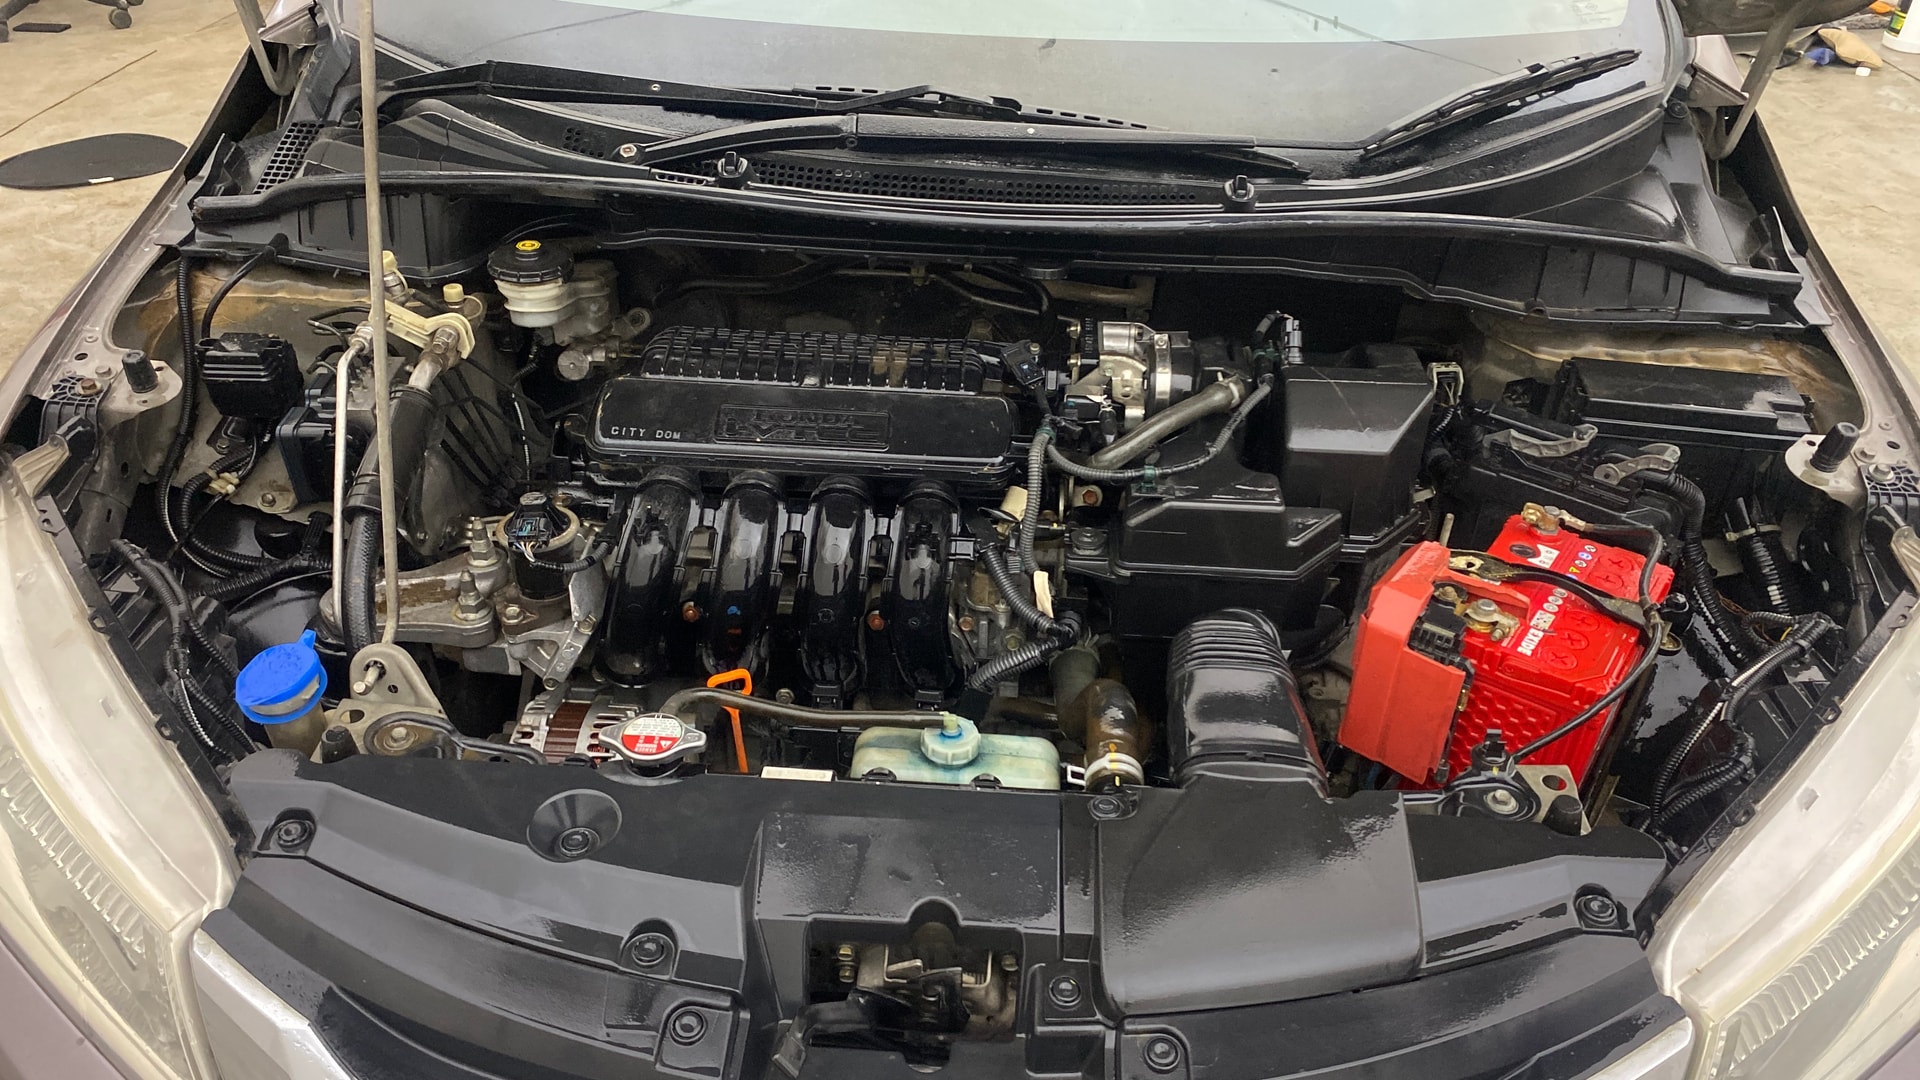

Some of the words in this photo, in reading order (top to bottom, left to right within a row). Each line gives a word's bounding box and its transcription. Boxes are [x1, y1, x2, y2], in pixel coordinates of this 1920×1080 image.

[611, 426, 646, 437] CITY
[656, 430, 681, 440] DOM
[1517, 628, 1544, 655] EXIDE
